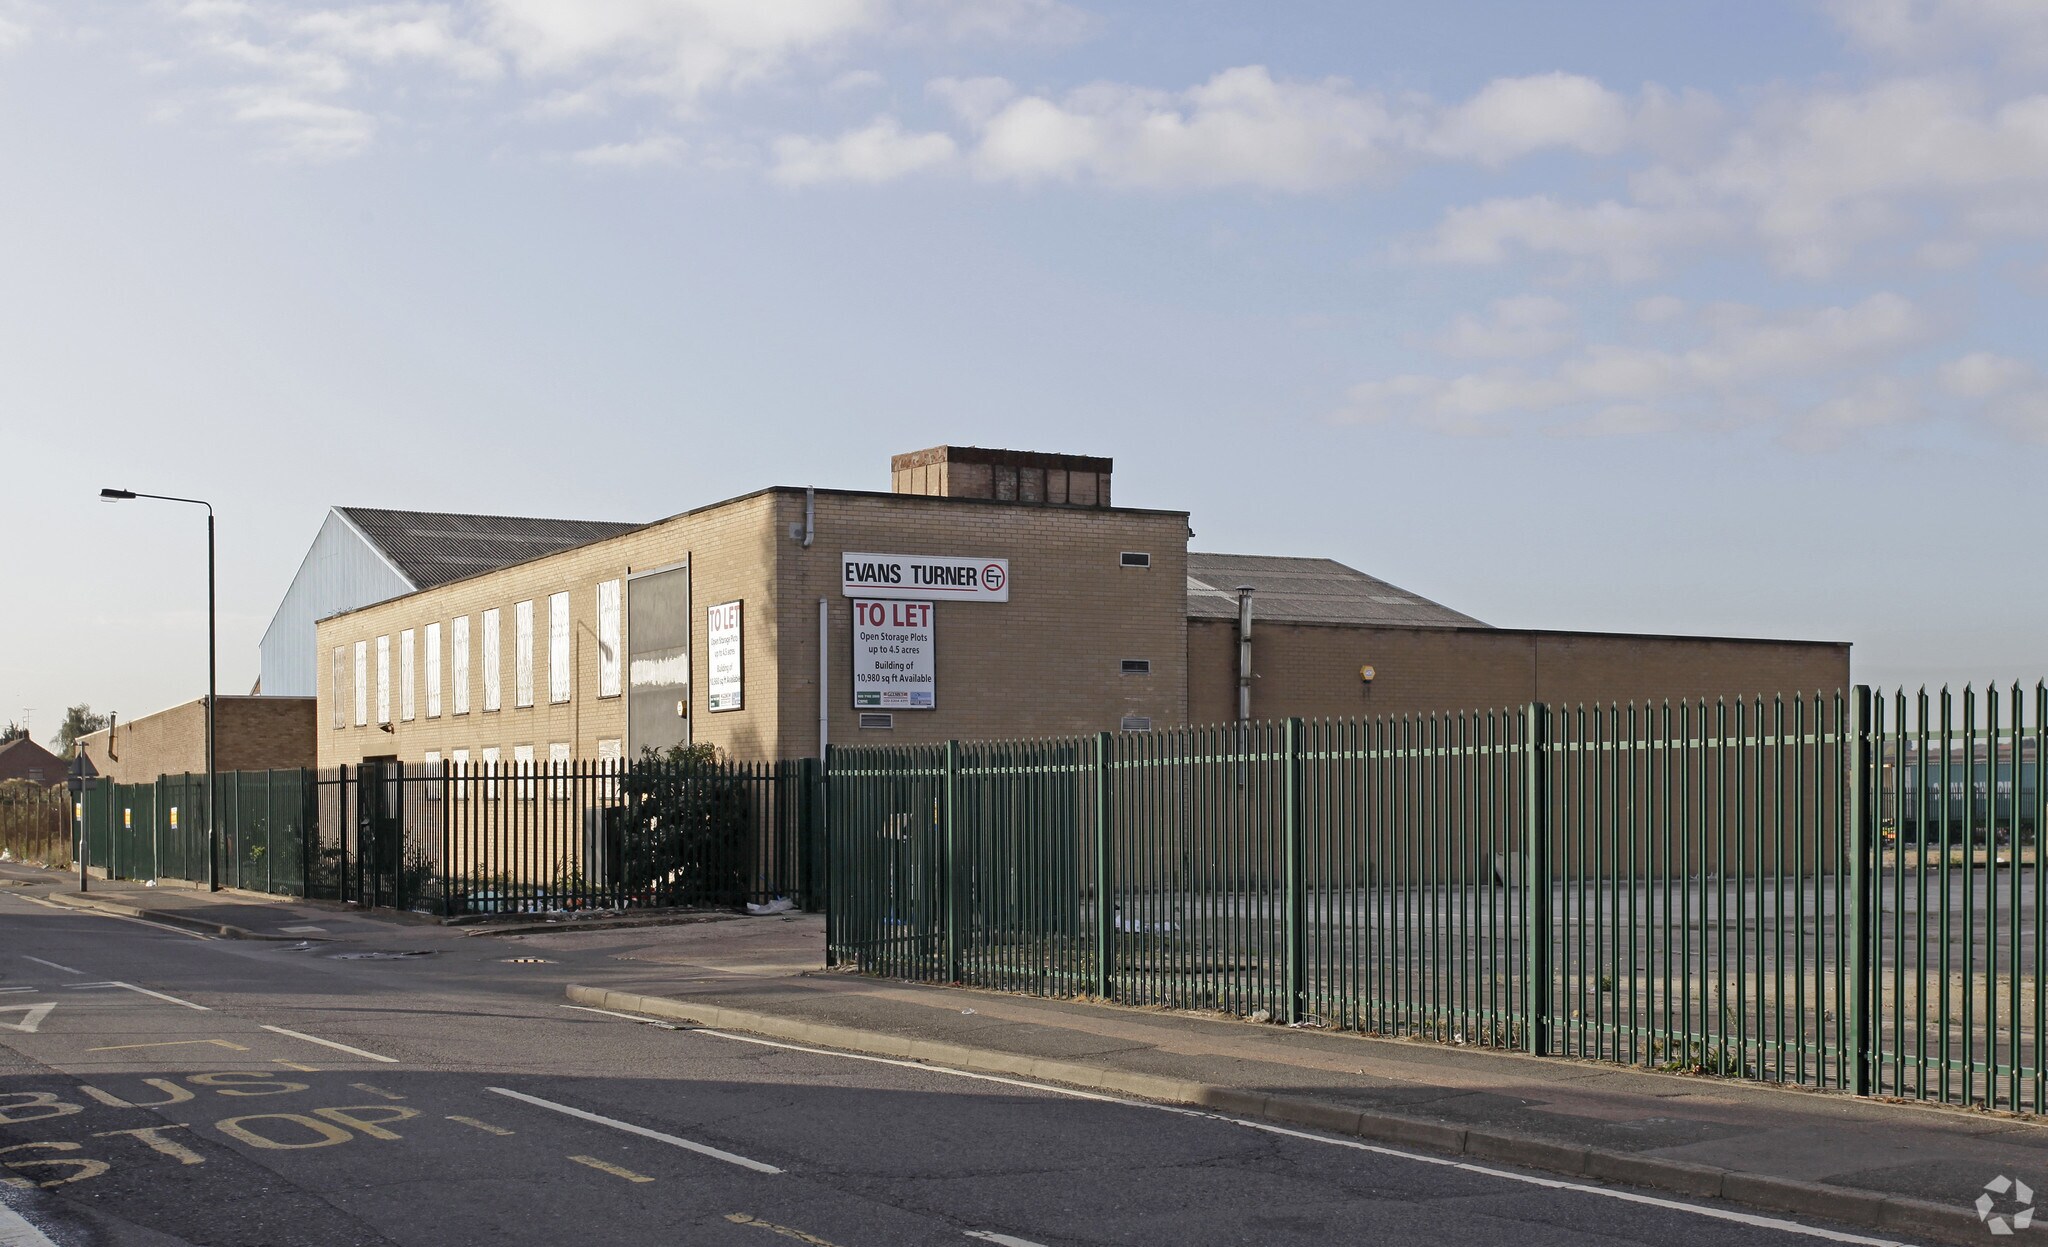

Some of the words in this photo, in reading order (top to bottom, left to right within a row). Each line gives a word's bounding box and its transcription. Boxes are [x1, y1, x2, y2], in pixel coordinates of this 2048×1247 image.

[845, 562, 901, 584] EVANS
[911, 565, 978, 586] TURNER
[986, 570, 1001, 587] ET
[710, 608, 721, 632] TO
[723, 605, 740, 630] LET
[856, 603, 885, 627] TO
[893, 604, 930, 627] LET
[860, 632, 879, 642] Open
[881, 632, 909, 643] Storage
[910, 633, 928, 642] Plots
[868, 646, 878, 655] up
[880, 645, 887, 653] to
[889, 645, 900, 653] 4.5
[875, 661, 904, 671] Building
[906, 661, 914, 670] of
[857, 673, 880, 683] 10,980
[881, 675, 890, 684] sq
[892, 674, 898, 682] ft
[899, 674, 932, 683] Available
[0, 1072, 310, 1124] BUS
[0, 1105, 422, 1189] STOP
